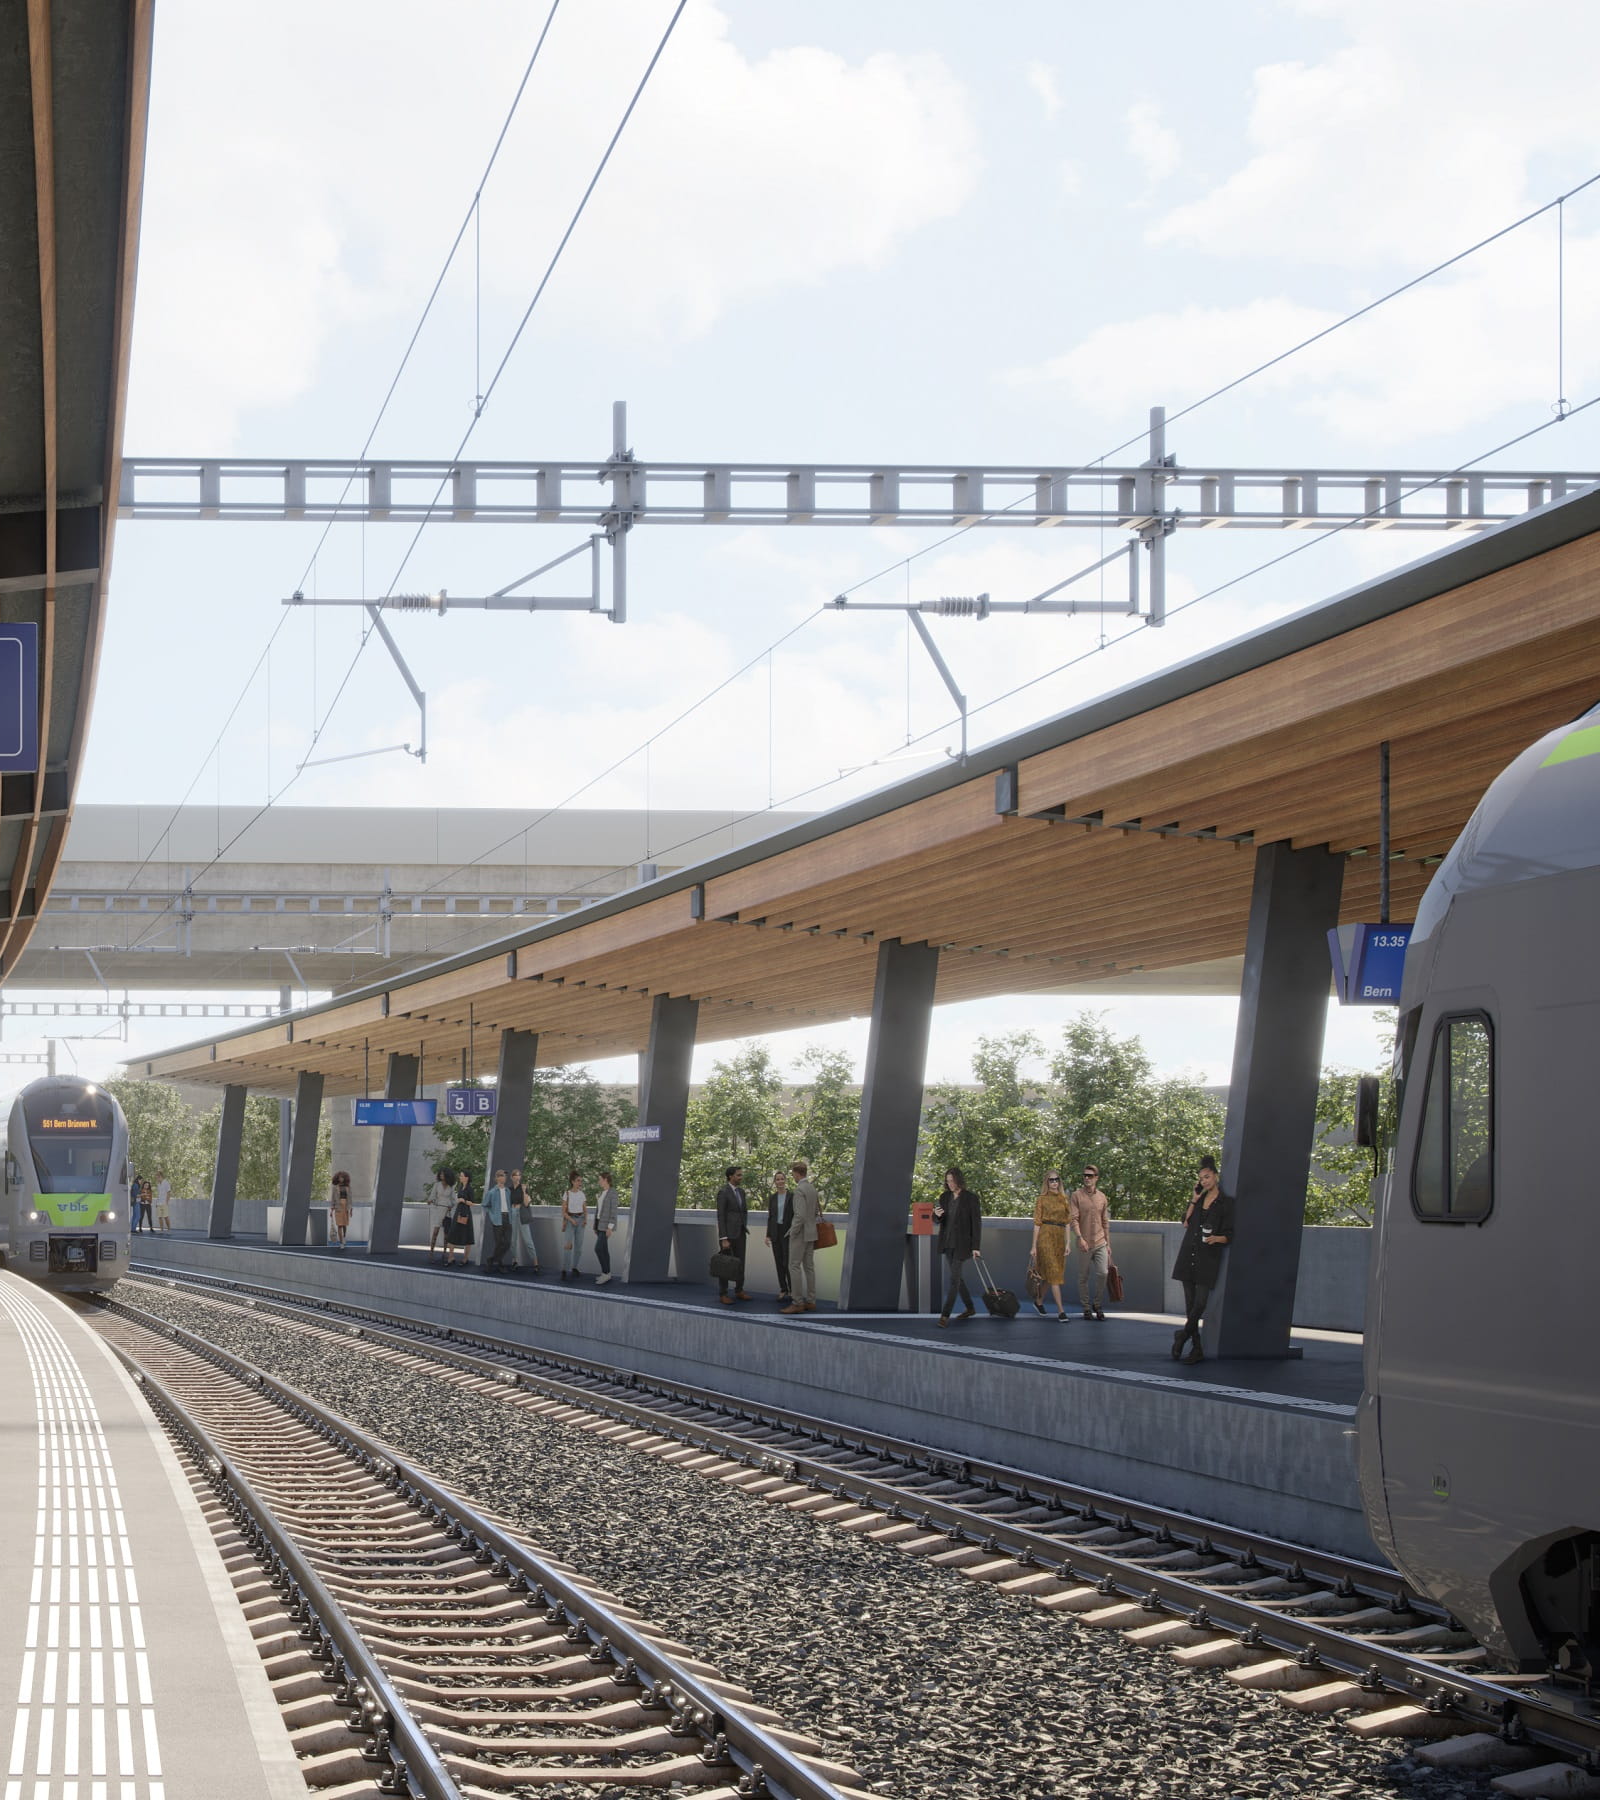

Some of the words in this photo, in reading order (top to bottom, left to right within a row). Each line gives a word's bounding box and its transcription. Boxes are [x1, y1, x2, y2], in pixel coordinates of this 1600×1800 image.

[1373, 936, 1406, 947] 13.35
[1364, 986, 1392, 997] Bern
[455, 1097, 464, 1111] 5
[479, 1097, 490, 1111] B
[70, 1202, 88, 1212] bls
